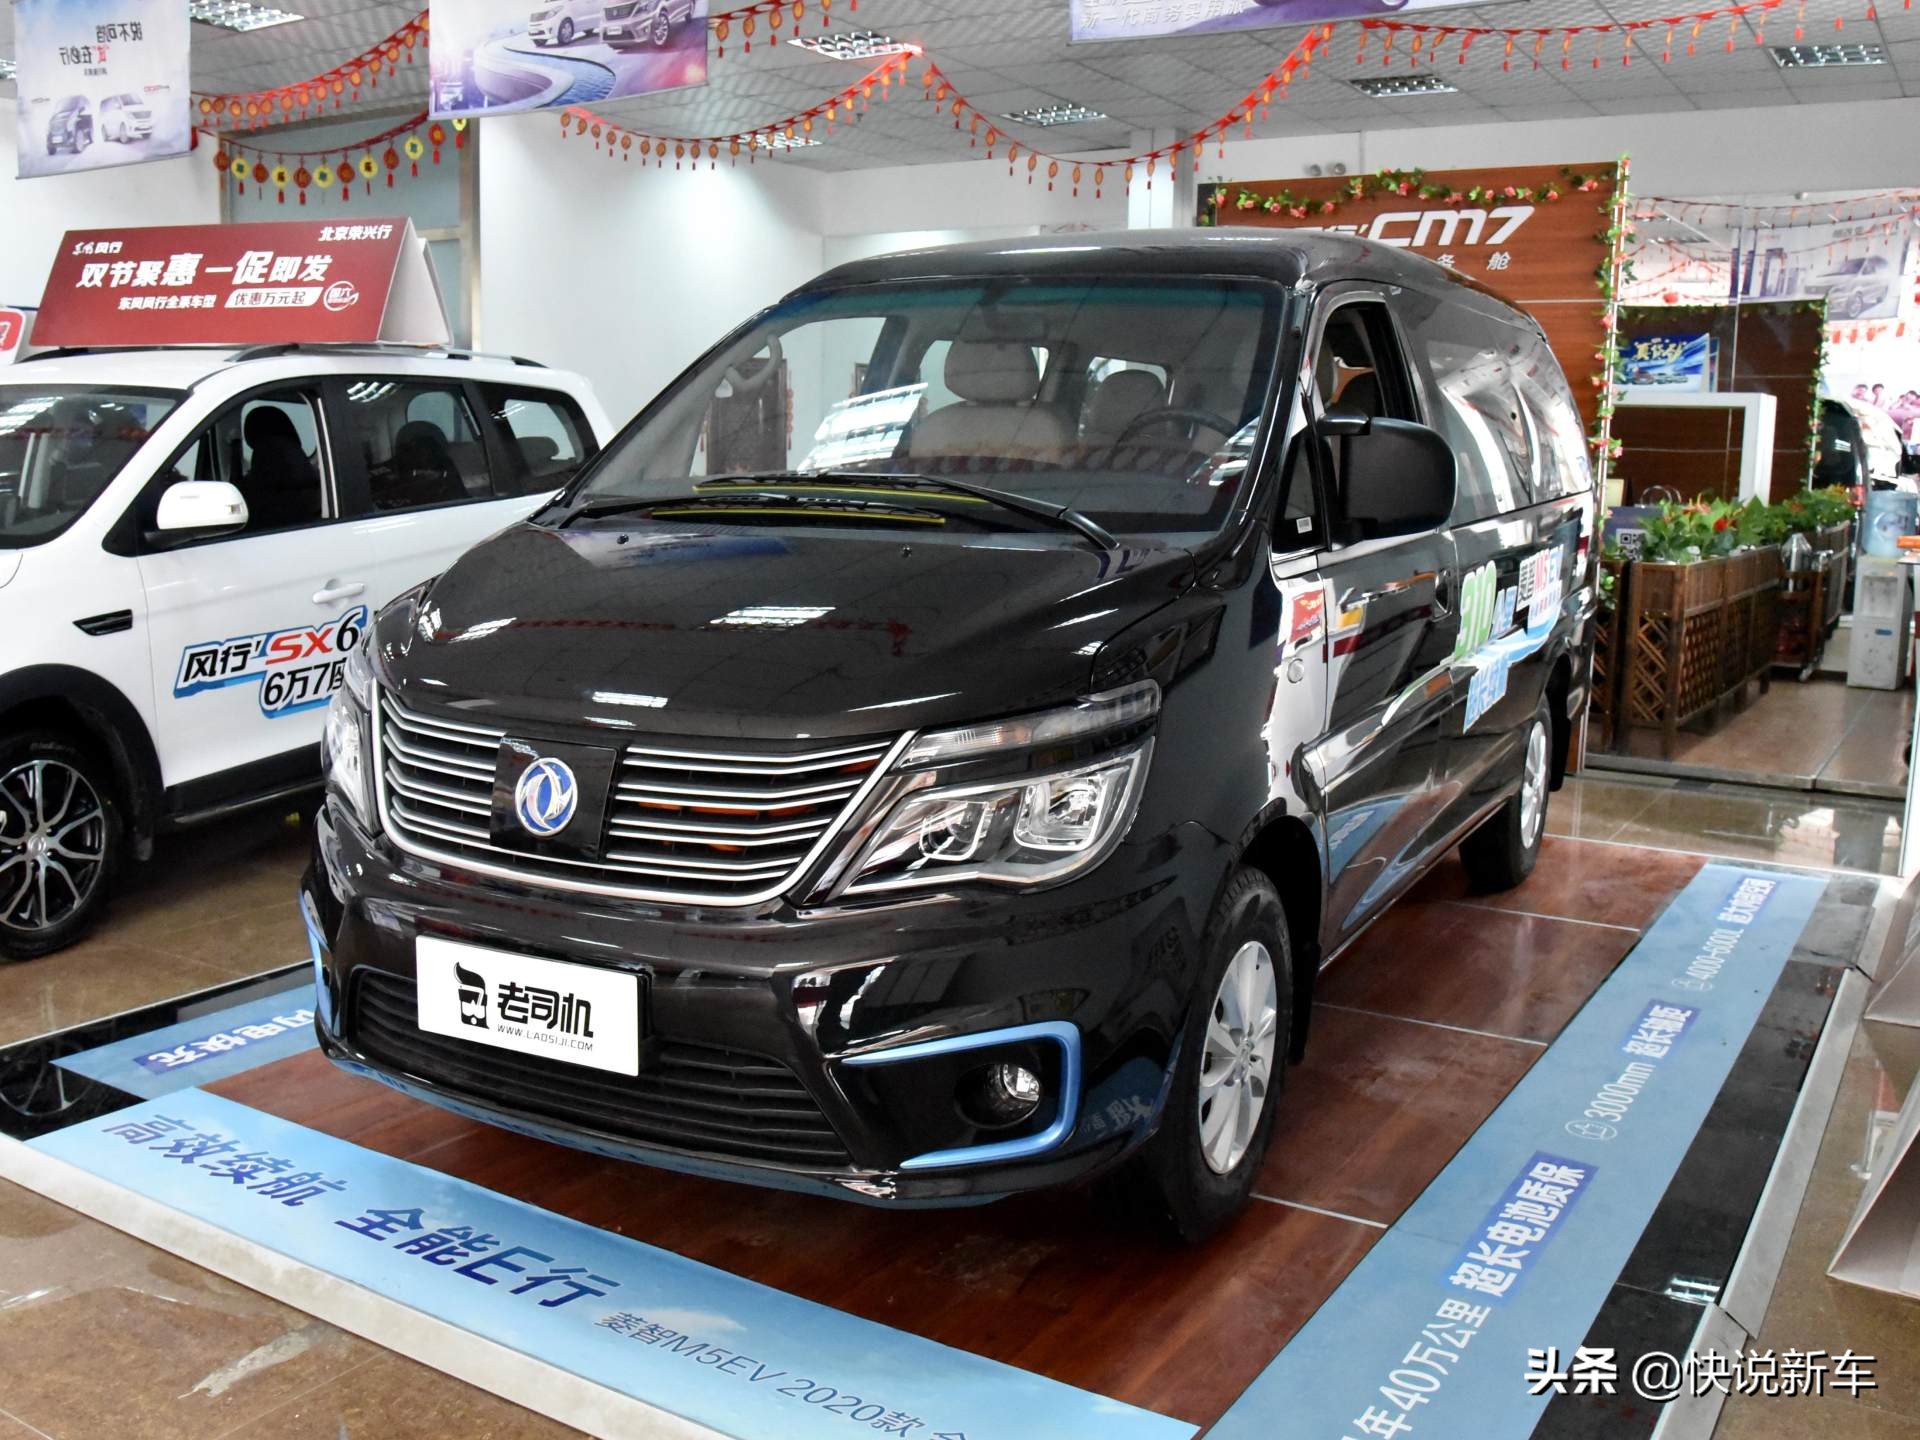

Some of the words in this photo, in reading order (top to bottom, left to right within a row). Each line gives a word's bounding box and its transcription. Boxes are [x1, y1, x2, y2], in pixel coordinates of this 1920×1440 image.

[318, 225, 393, 242] 北京荣兴行
[117, 295, 217, 311] 东风风行全系车型
[234, 290, 308, 306] 优惠万元起
[497, 981, 594, 1038] 老司机
[497, 1024, 593, 1051] WWW.LAOSIJI.COM
[1584, 1061, 1656, 1122] 3000mm
[101, 1113, 350, 1208] 高效续航
[334, 1207, 622, 1308] 全能E行
[1449, 1161, 1585, 1297] 超长电池质保
[594, 1311, 787, 1383] 菱智M5EV
[776, 1378, 925, 1439] 2020款
[1341, 1298, 1492, 1440] 年40万公里
